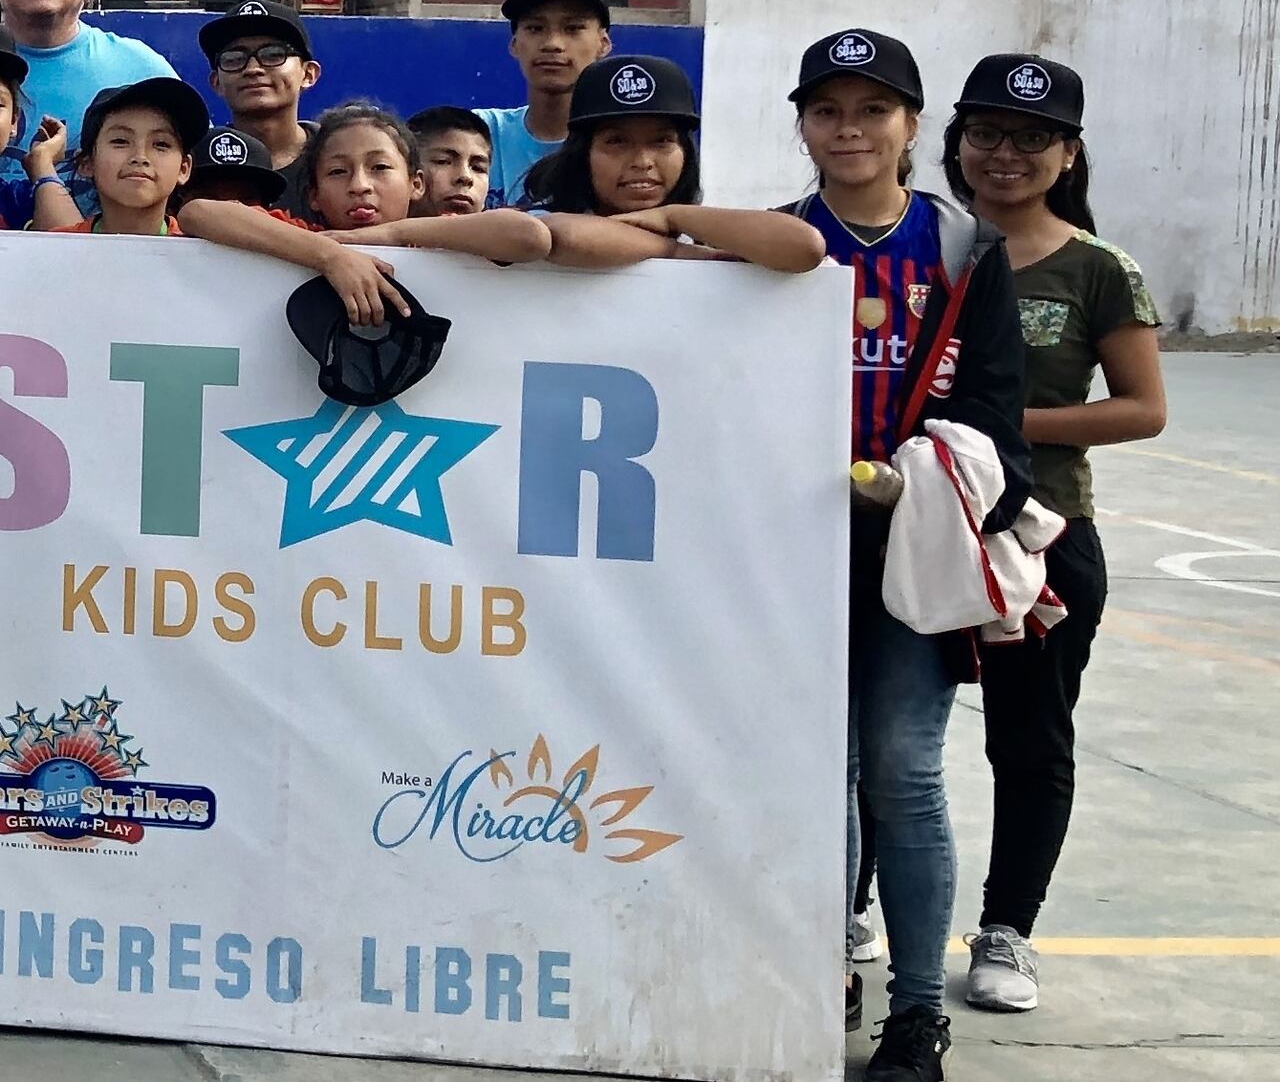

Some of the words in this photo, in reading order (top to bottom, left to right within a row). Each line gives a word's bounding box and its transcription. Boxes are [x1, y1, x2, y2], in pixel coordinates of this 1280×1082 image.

[62, 563, 259, 644] KIDS
[300, 576, 528, 656] CLUB
[46, 790, 79, 807] AND
[80, 783, 210, 823] Strikes
[372, 750, 587, 863] Miracle
[381, 771, 420, 786] Make
[424, 775, 433, 786] a
[0, 841, 30, 849] FAMILY
[360, 936, 572, 1022] LIBRE
